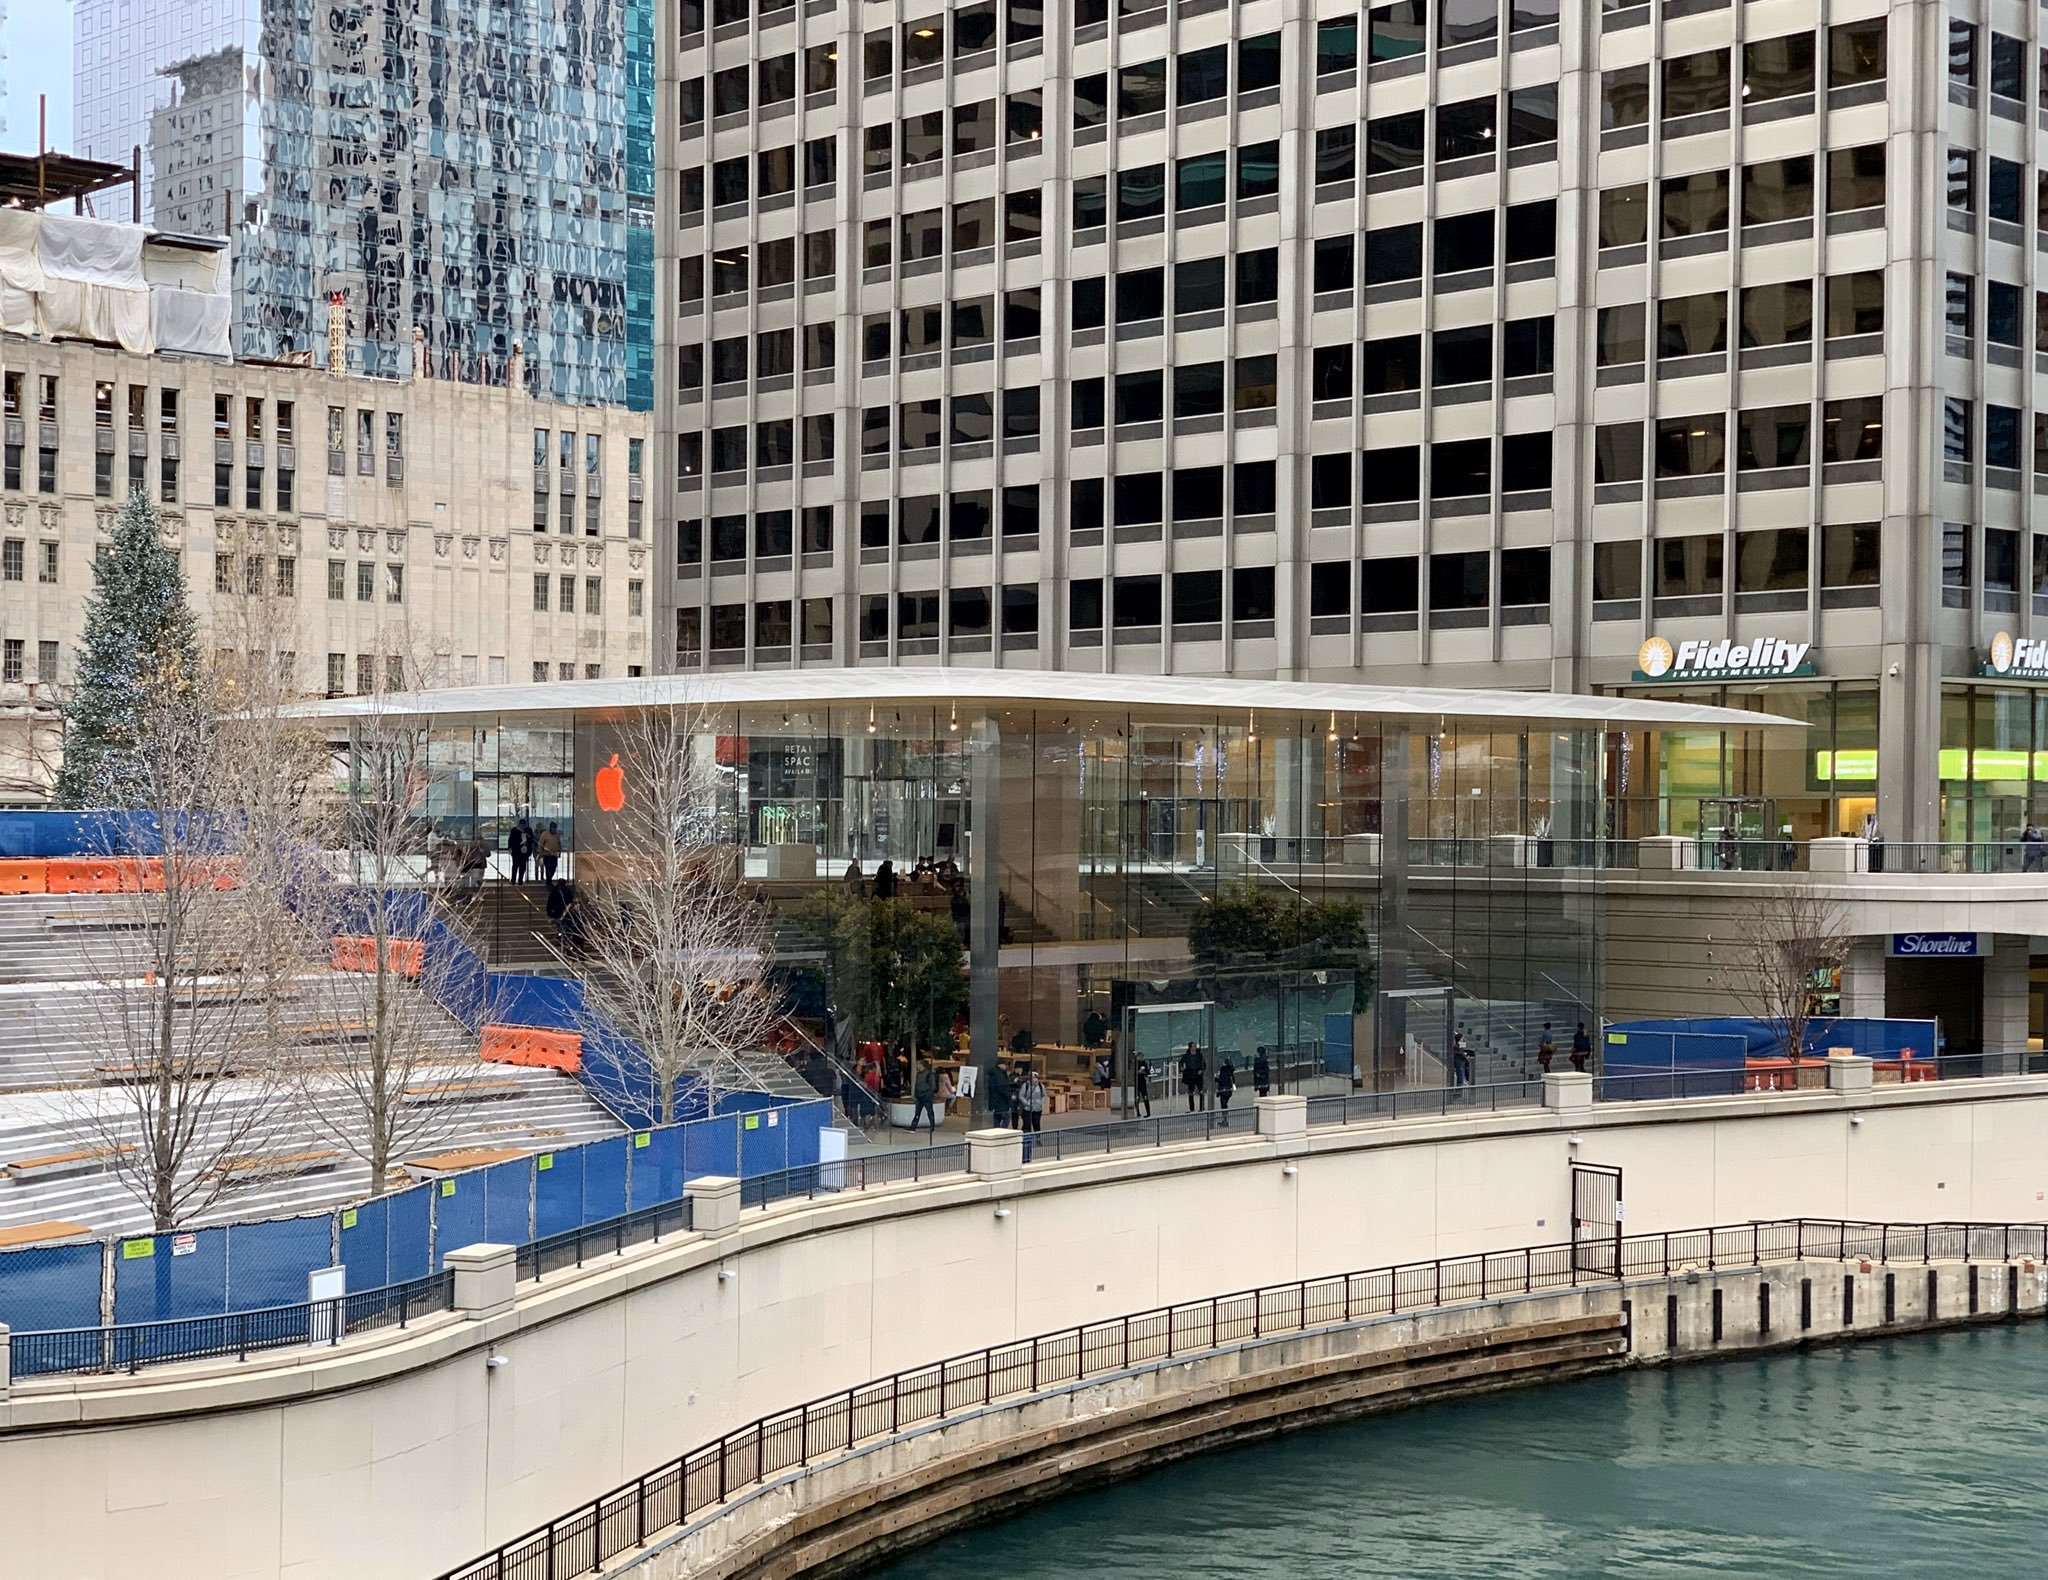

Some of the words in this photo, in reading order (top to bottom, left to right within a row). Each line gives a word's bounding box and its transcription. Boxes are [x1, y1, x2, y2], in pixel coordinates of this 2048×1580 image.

[1675, 637, 1811, 674] Fidelity
[1673, 667, 1780, 678] INVESTMENTS
[1900, 934, 1972, 953] Shoreline
